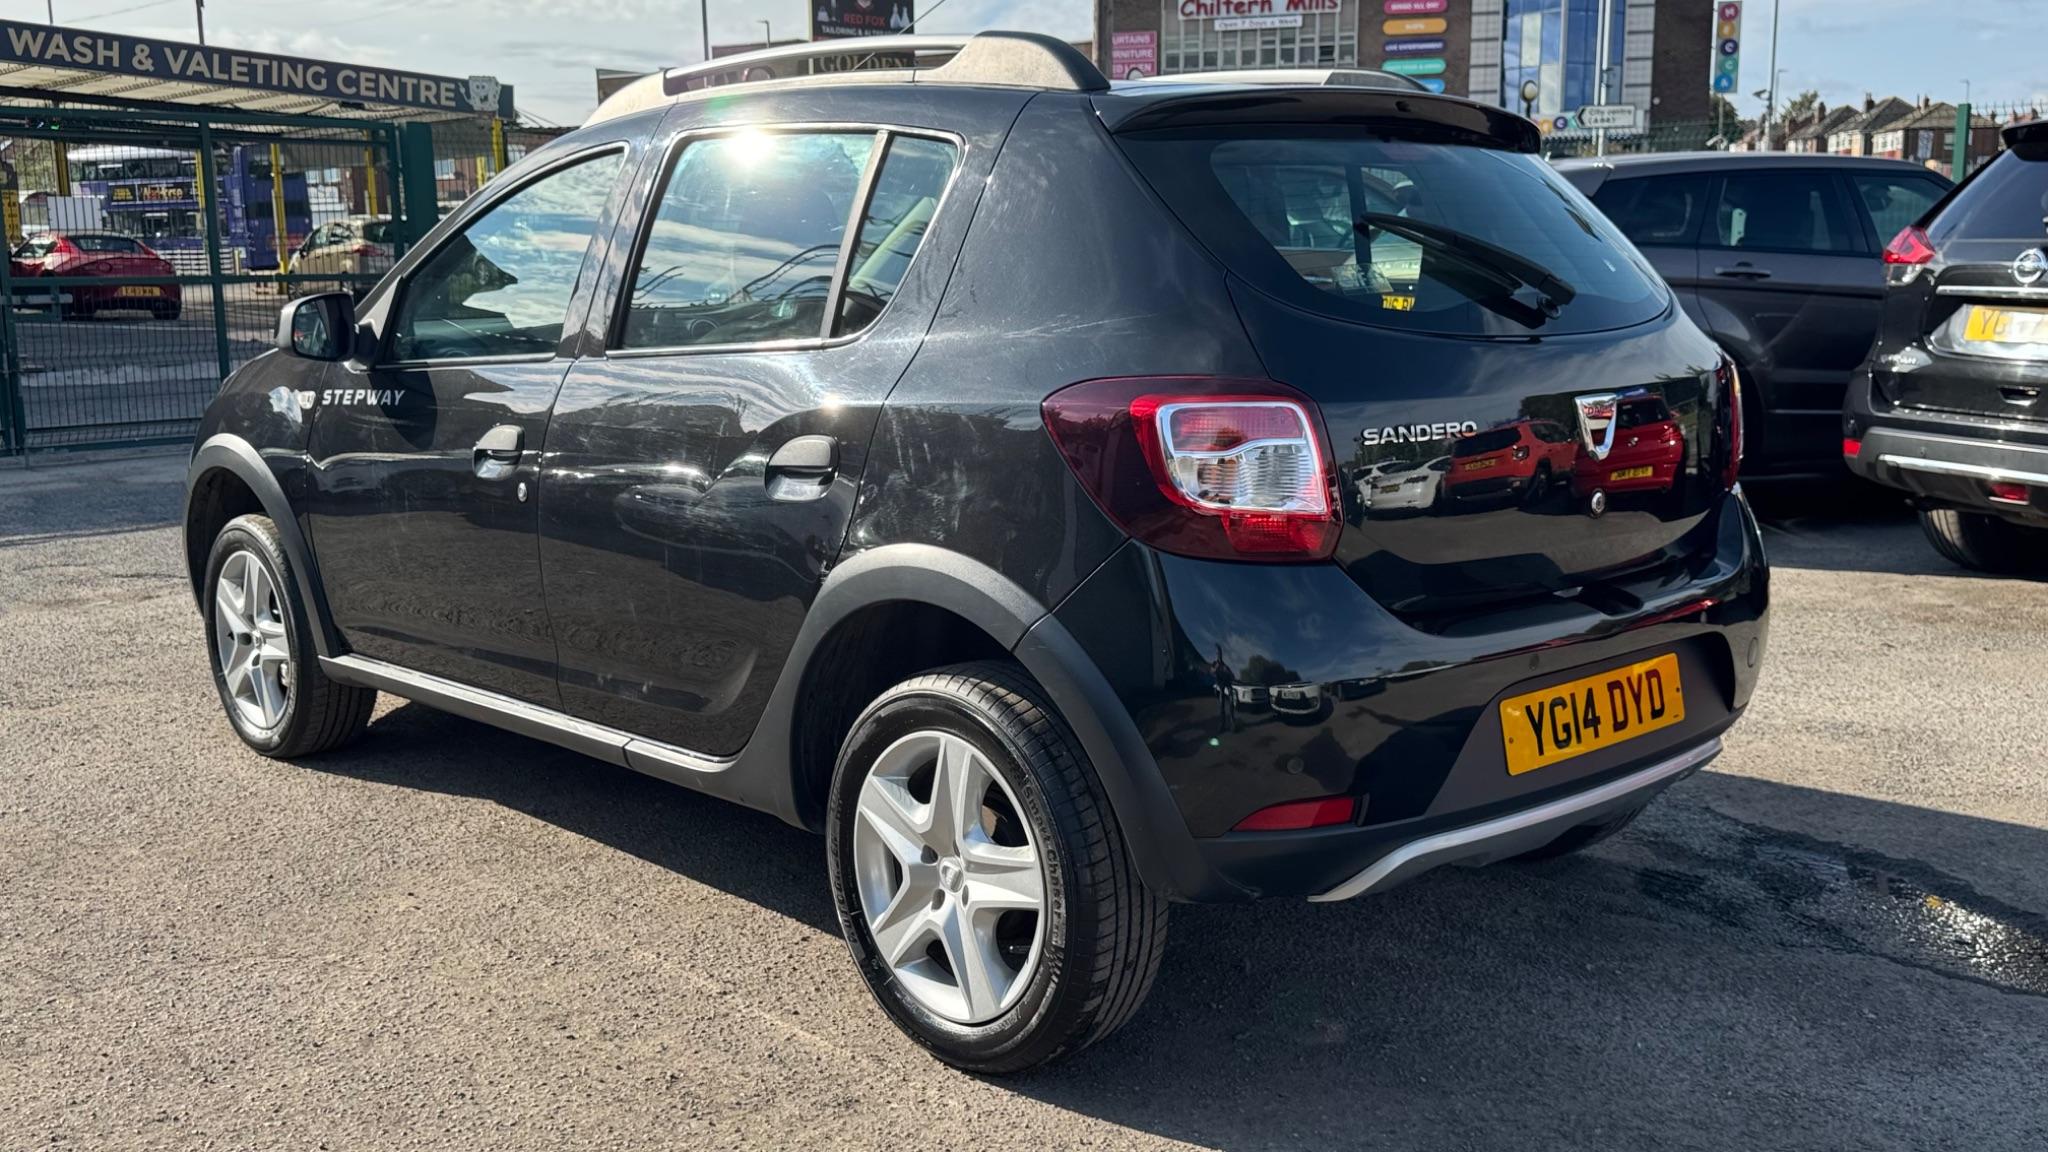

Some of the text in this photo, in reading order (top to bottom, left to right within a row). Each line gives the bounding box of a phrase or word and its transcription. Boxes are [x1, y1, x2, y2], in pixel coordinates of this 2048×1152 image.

[1180, 0, 1338, 17] Chiltern Mills
[844, 13, 886, 27] RED FOX
[821, 25, 857, 36] TAILORING
[1112, 35, 1150, 46] URTAINS
[7, 27, 457, 108] WASH & VALETING CENTRE
[820, 53, 908, 72] GOLDEN
[322, 389, 405, 405] STEPWAY
[1362, 421, 1478, 446] SANDERO
[1525, 668, 1666, 756] YG14 DYD
